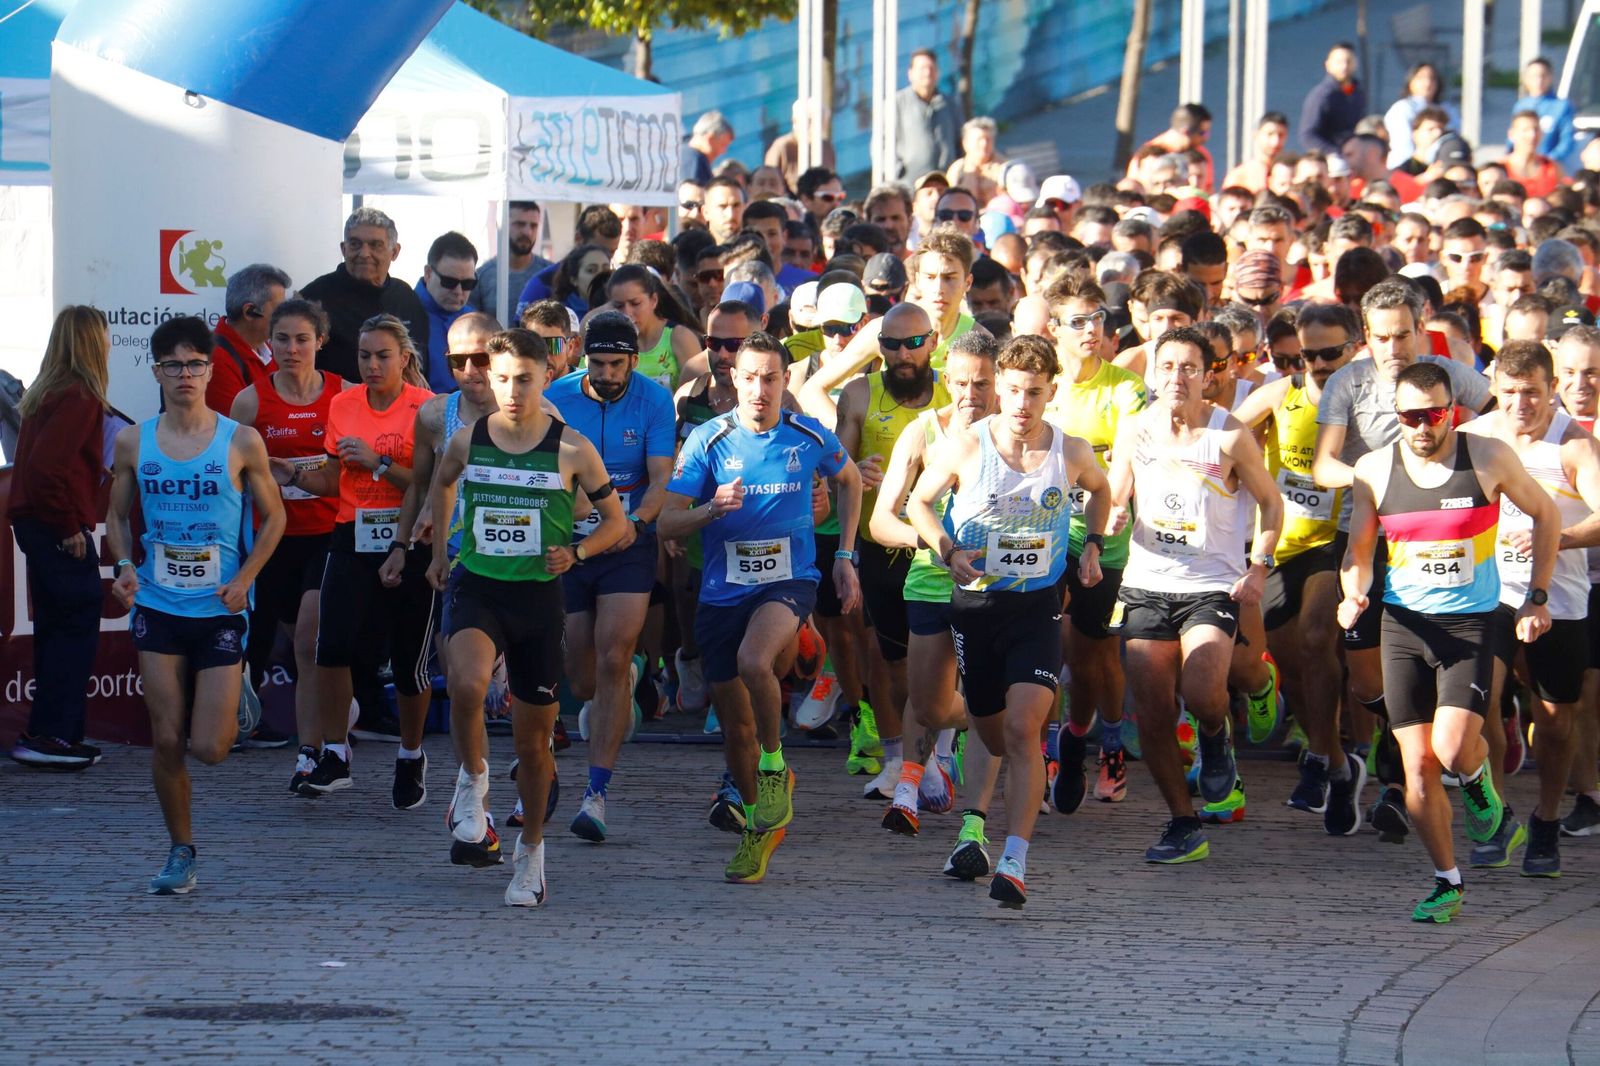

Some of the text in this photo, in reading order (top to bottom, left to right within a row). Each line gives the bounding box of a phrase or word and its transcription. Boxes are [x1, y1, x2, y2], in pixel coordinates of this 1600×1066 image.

[144, 474, 219, 501] nerja
[742, 481, 801, 496] OTASIERRA
[1286, 490, 1320, 507] 100
[371, 528, 394, 540] 10
[484, 529, 526, 542] 508
[1155, 531, 1188, 546] 194
[1000, 553, 1038, 565] 449
[1503, 551, 1534, 563] 28
[167, 562, 206, 577] 556
[739, 558, 777, 573] 530
[1421, 562, 1461, 575] 484
